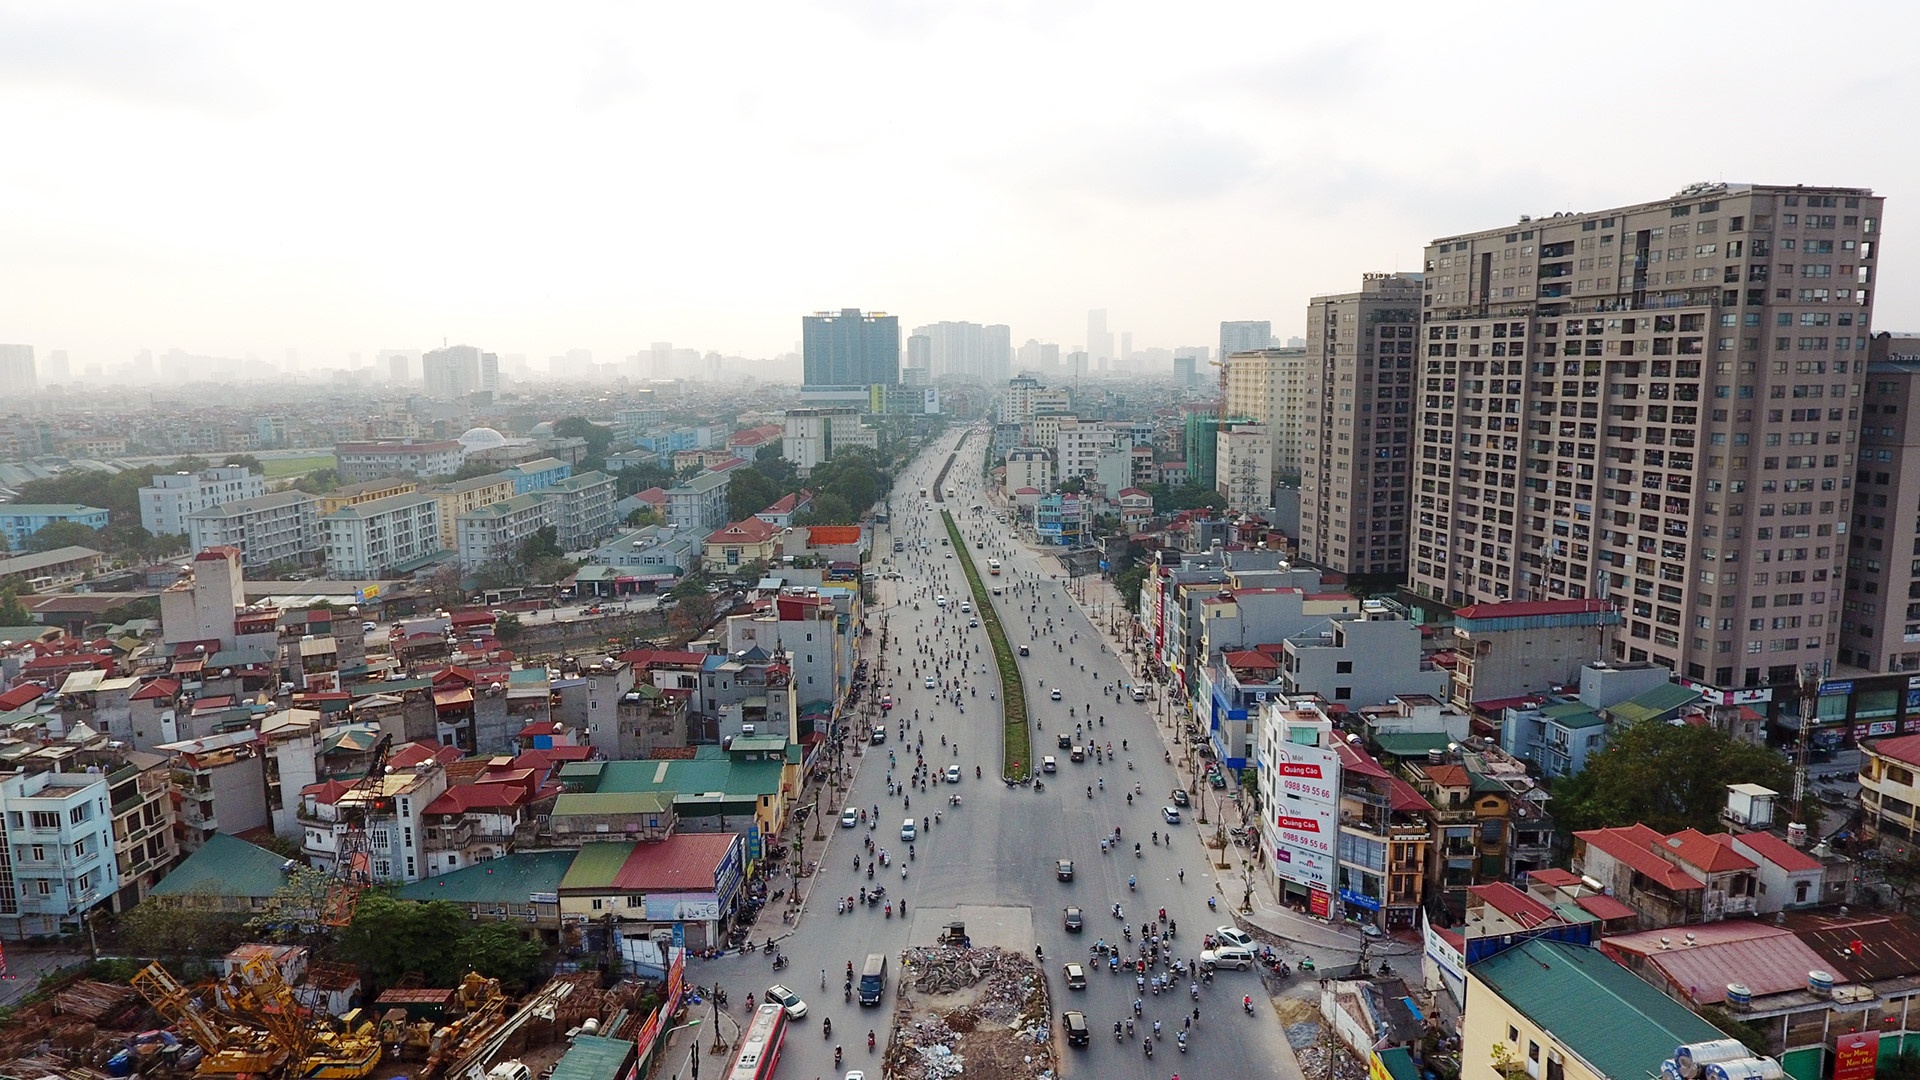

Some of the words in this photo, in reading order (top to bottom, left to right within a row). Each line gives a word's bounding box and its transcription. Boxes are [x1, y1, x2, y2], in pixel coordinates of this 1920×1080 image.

[1882, 722, 1896, 733] 5%
[1284, 766, 1304, 775] Quảng
[1305, 767, 1318, 775] Cáo
[1284, 780, 1300, 791] 0988
[1301, 784, 1310, 793] 59
[1311, 787, 1320, 796] 55
[1321, 789, 1330, 799] 66
[1282, 818, 1302, 828] Quảng
[1282, 831, 1299, 842] 0988
[1300, 836, 1309, 845] 59
[1310, 839, 1318, 848] 55
[1319, 841, 1328, 851] 66
